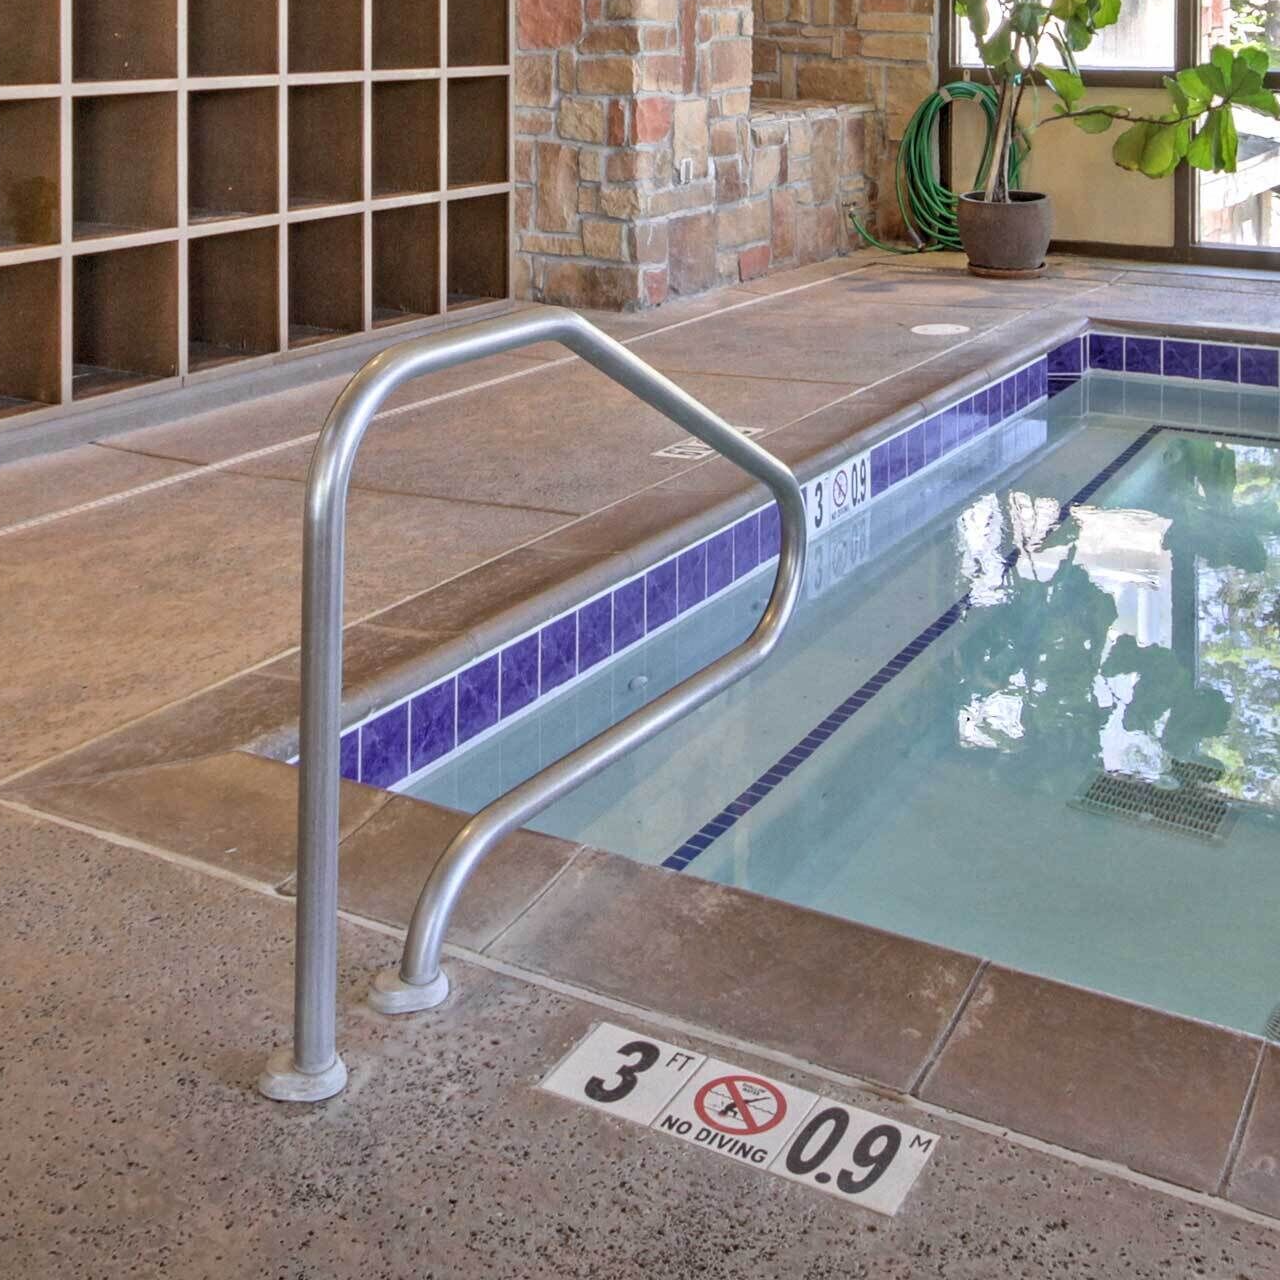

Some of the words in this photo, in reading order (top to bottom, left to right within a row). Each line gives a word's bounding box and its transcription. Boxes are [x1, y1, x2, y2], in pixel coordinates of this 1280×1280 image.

[815, 482, 823, 528] 3
[852, 459, 866, 507] 0.9
[584, 1041, 660, 1103] 3
[666, 1053, 695, 1072] FT
[785, 1107, 901, 1194] 0.9
[909, 1134, 932, 1153] M
[660, 1114, 692, 1136] NO
[696, 1127, 768, 1164] DIVING
